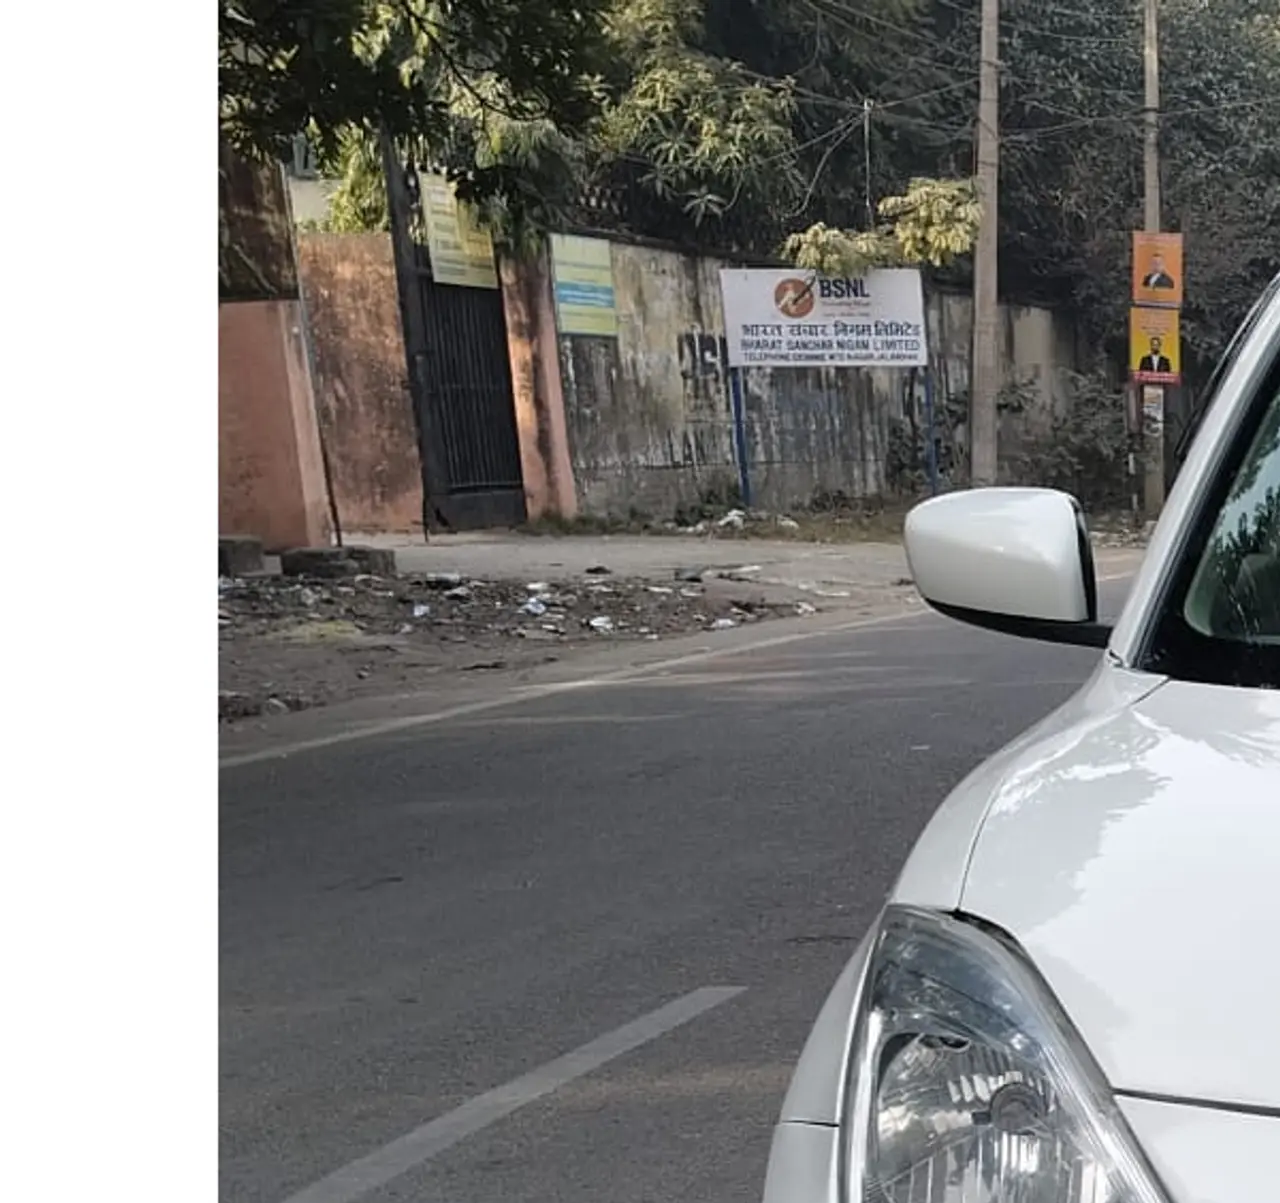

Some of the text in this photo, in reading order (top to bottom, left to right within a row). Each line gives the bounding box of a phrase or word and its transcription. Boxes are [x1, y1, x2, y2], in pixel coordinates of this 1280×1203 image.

[819, 277, 870, 298] BSNL
[741, 339, 920, 351] BHARAT SANCHAR NIGAM LIMITED
